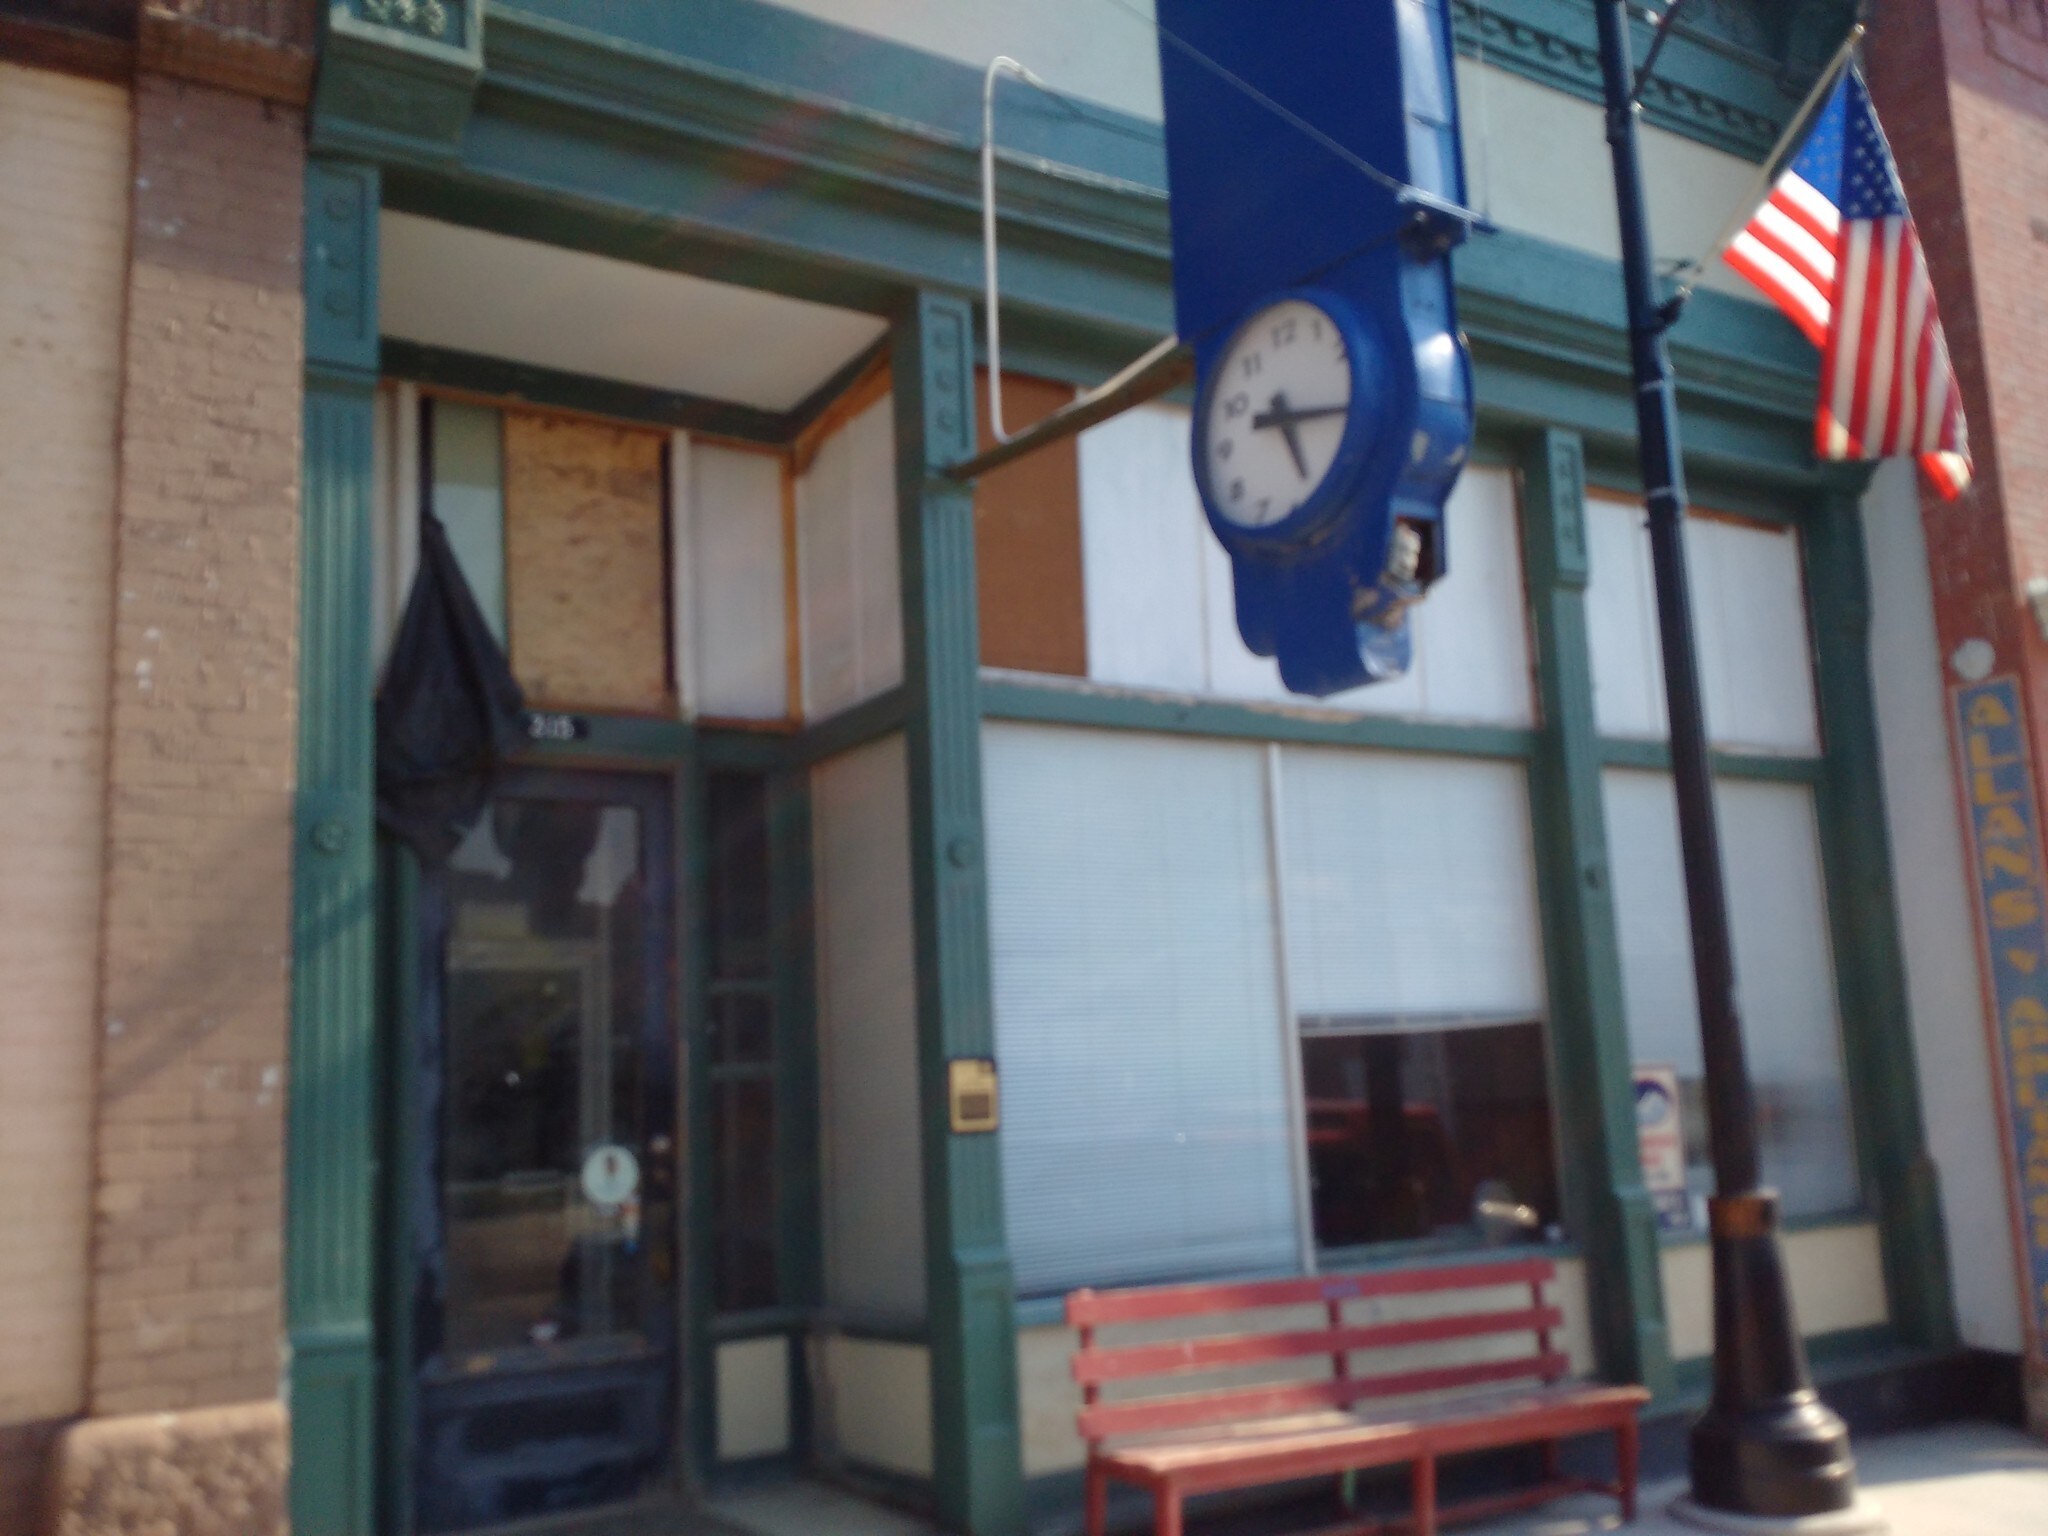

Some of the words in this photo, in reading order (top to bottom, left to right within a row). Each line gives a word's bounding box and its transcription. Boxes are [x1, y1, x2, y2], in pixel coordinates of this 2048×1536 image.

[1271, 319, 1297, 350] 12
[1243, 351, 1263, 379] 11
[1224, 392, 1251, 420] 10
